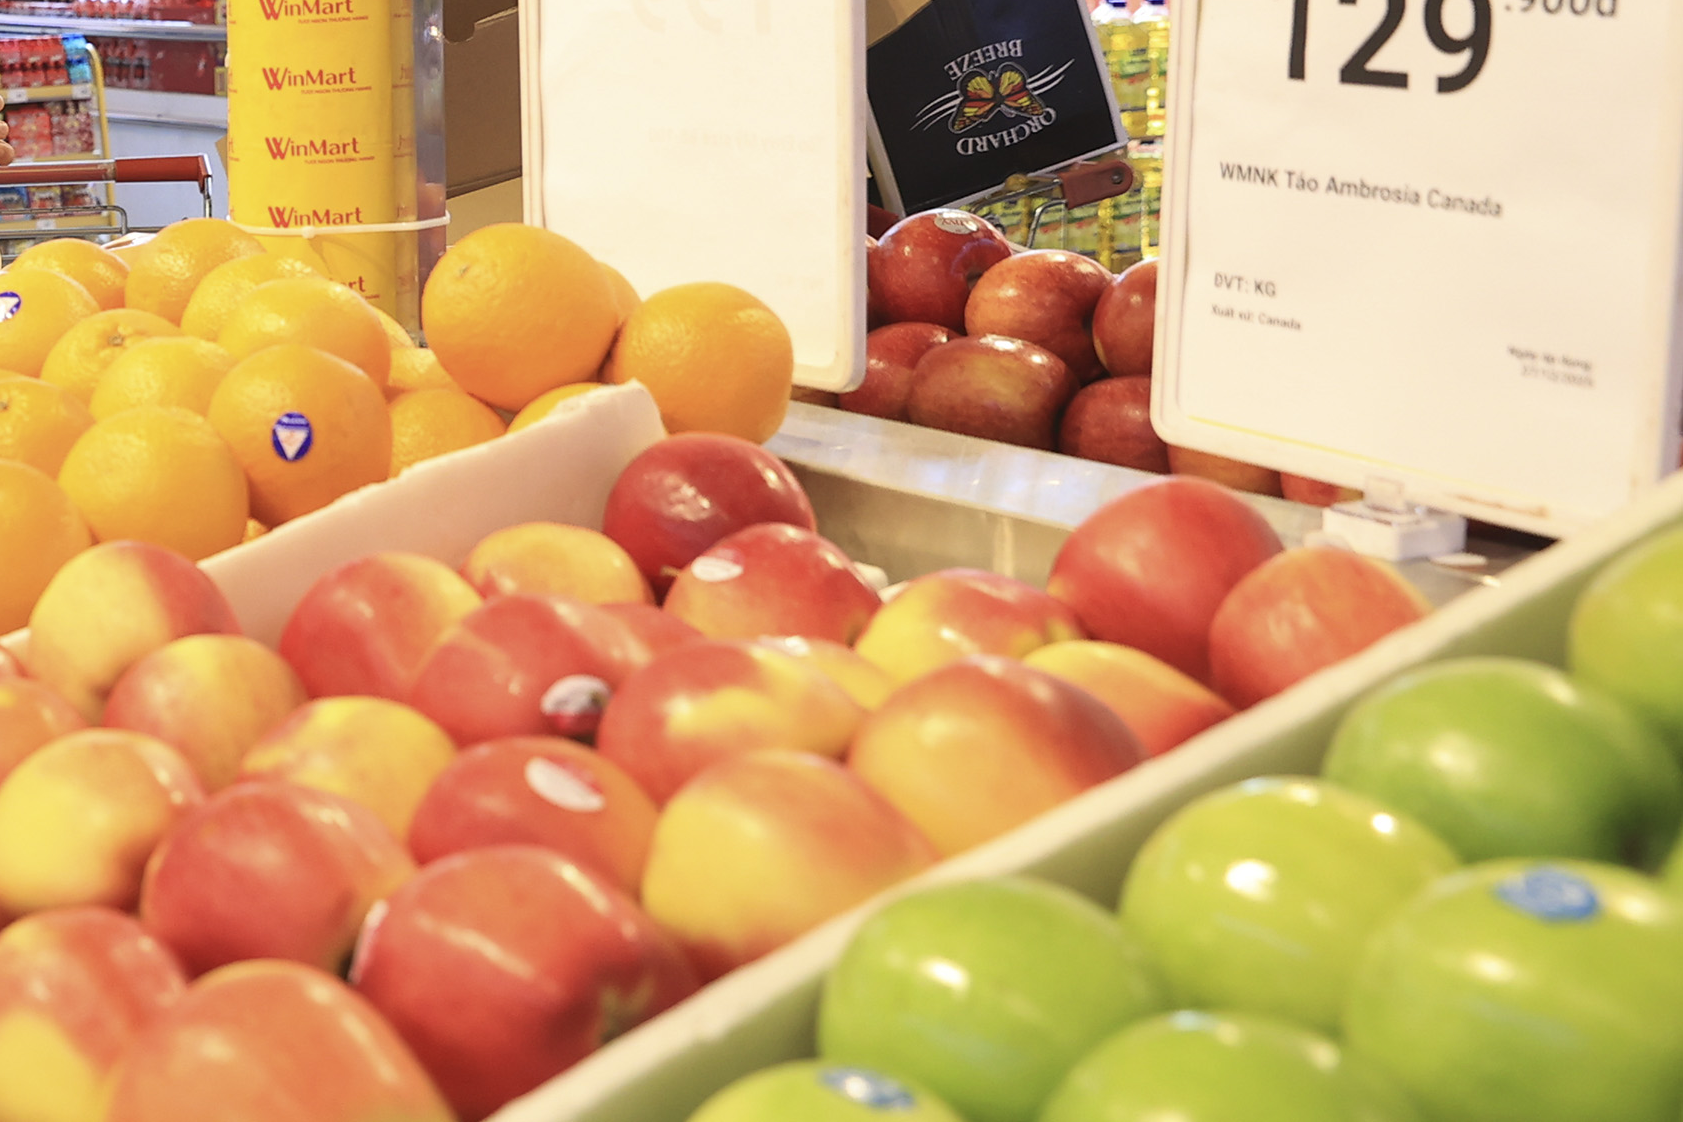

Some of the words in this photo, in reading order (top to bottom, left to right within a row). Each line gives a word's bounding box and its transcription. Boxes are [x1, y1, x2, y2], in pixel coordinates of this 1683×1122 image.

[943, 39, 1023, 81] BREEZE
[262, 67, 356, 90] WinMart
[956, 107, 1057, 156] ORCHARD
[265, 137, 360, 160] WinMart
[1219, 161, 1279, 188] WMNK
[1284, 169, 1318, 193] Táo
[1325, 176, 1420, 206] Ambrosia
[1427, 188, 1503, 218] Canada
[268, 206, 363, 228] WinMart
[1254, 278, 1276, 297] KG
[1258, 311, 1301, 330] Canada
